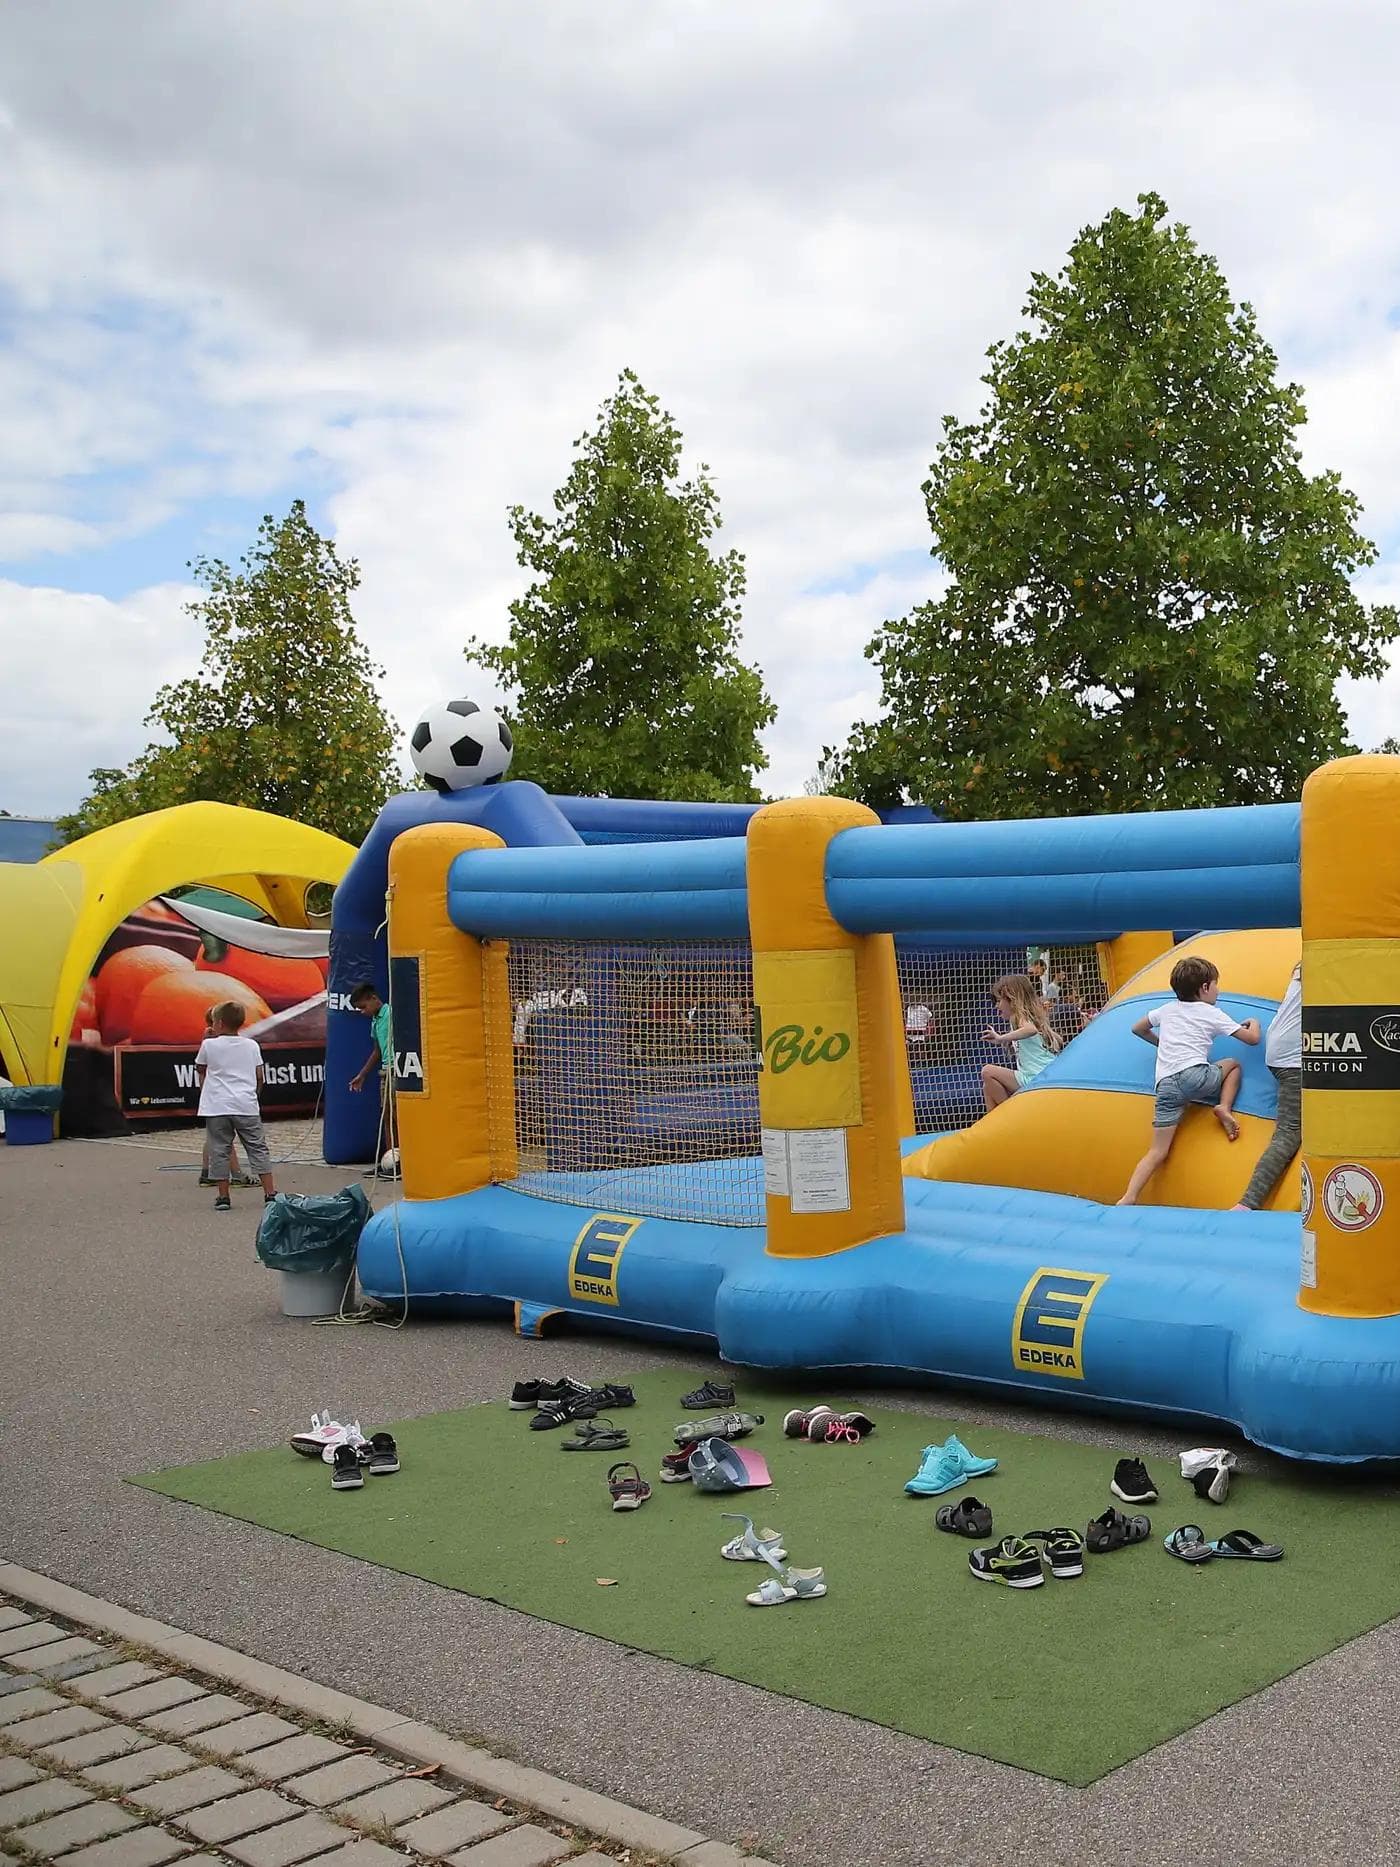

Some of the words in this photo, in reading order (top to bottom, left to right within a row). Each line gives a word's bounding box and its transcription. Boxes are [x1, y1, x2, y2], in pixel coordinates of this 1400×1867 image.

[765, 1024, 850, 1074] Bio
[301, 1064, 326, 1083] un
[575, 1280, 613, 1297] EDEKA
[1020, 1348, 1076, 1369] EDEKA
